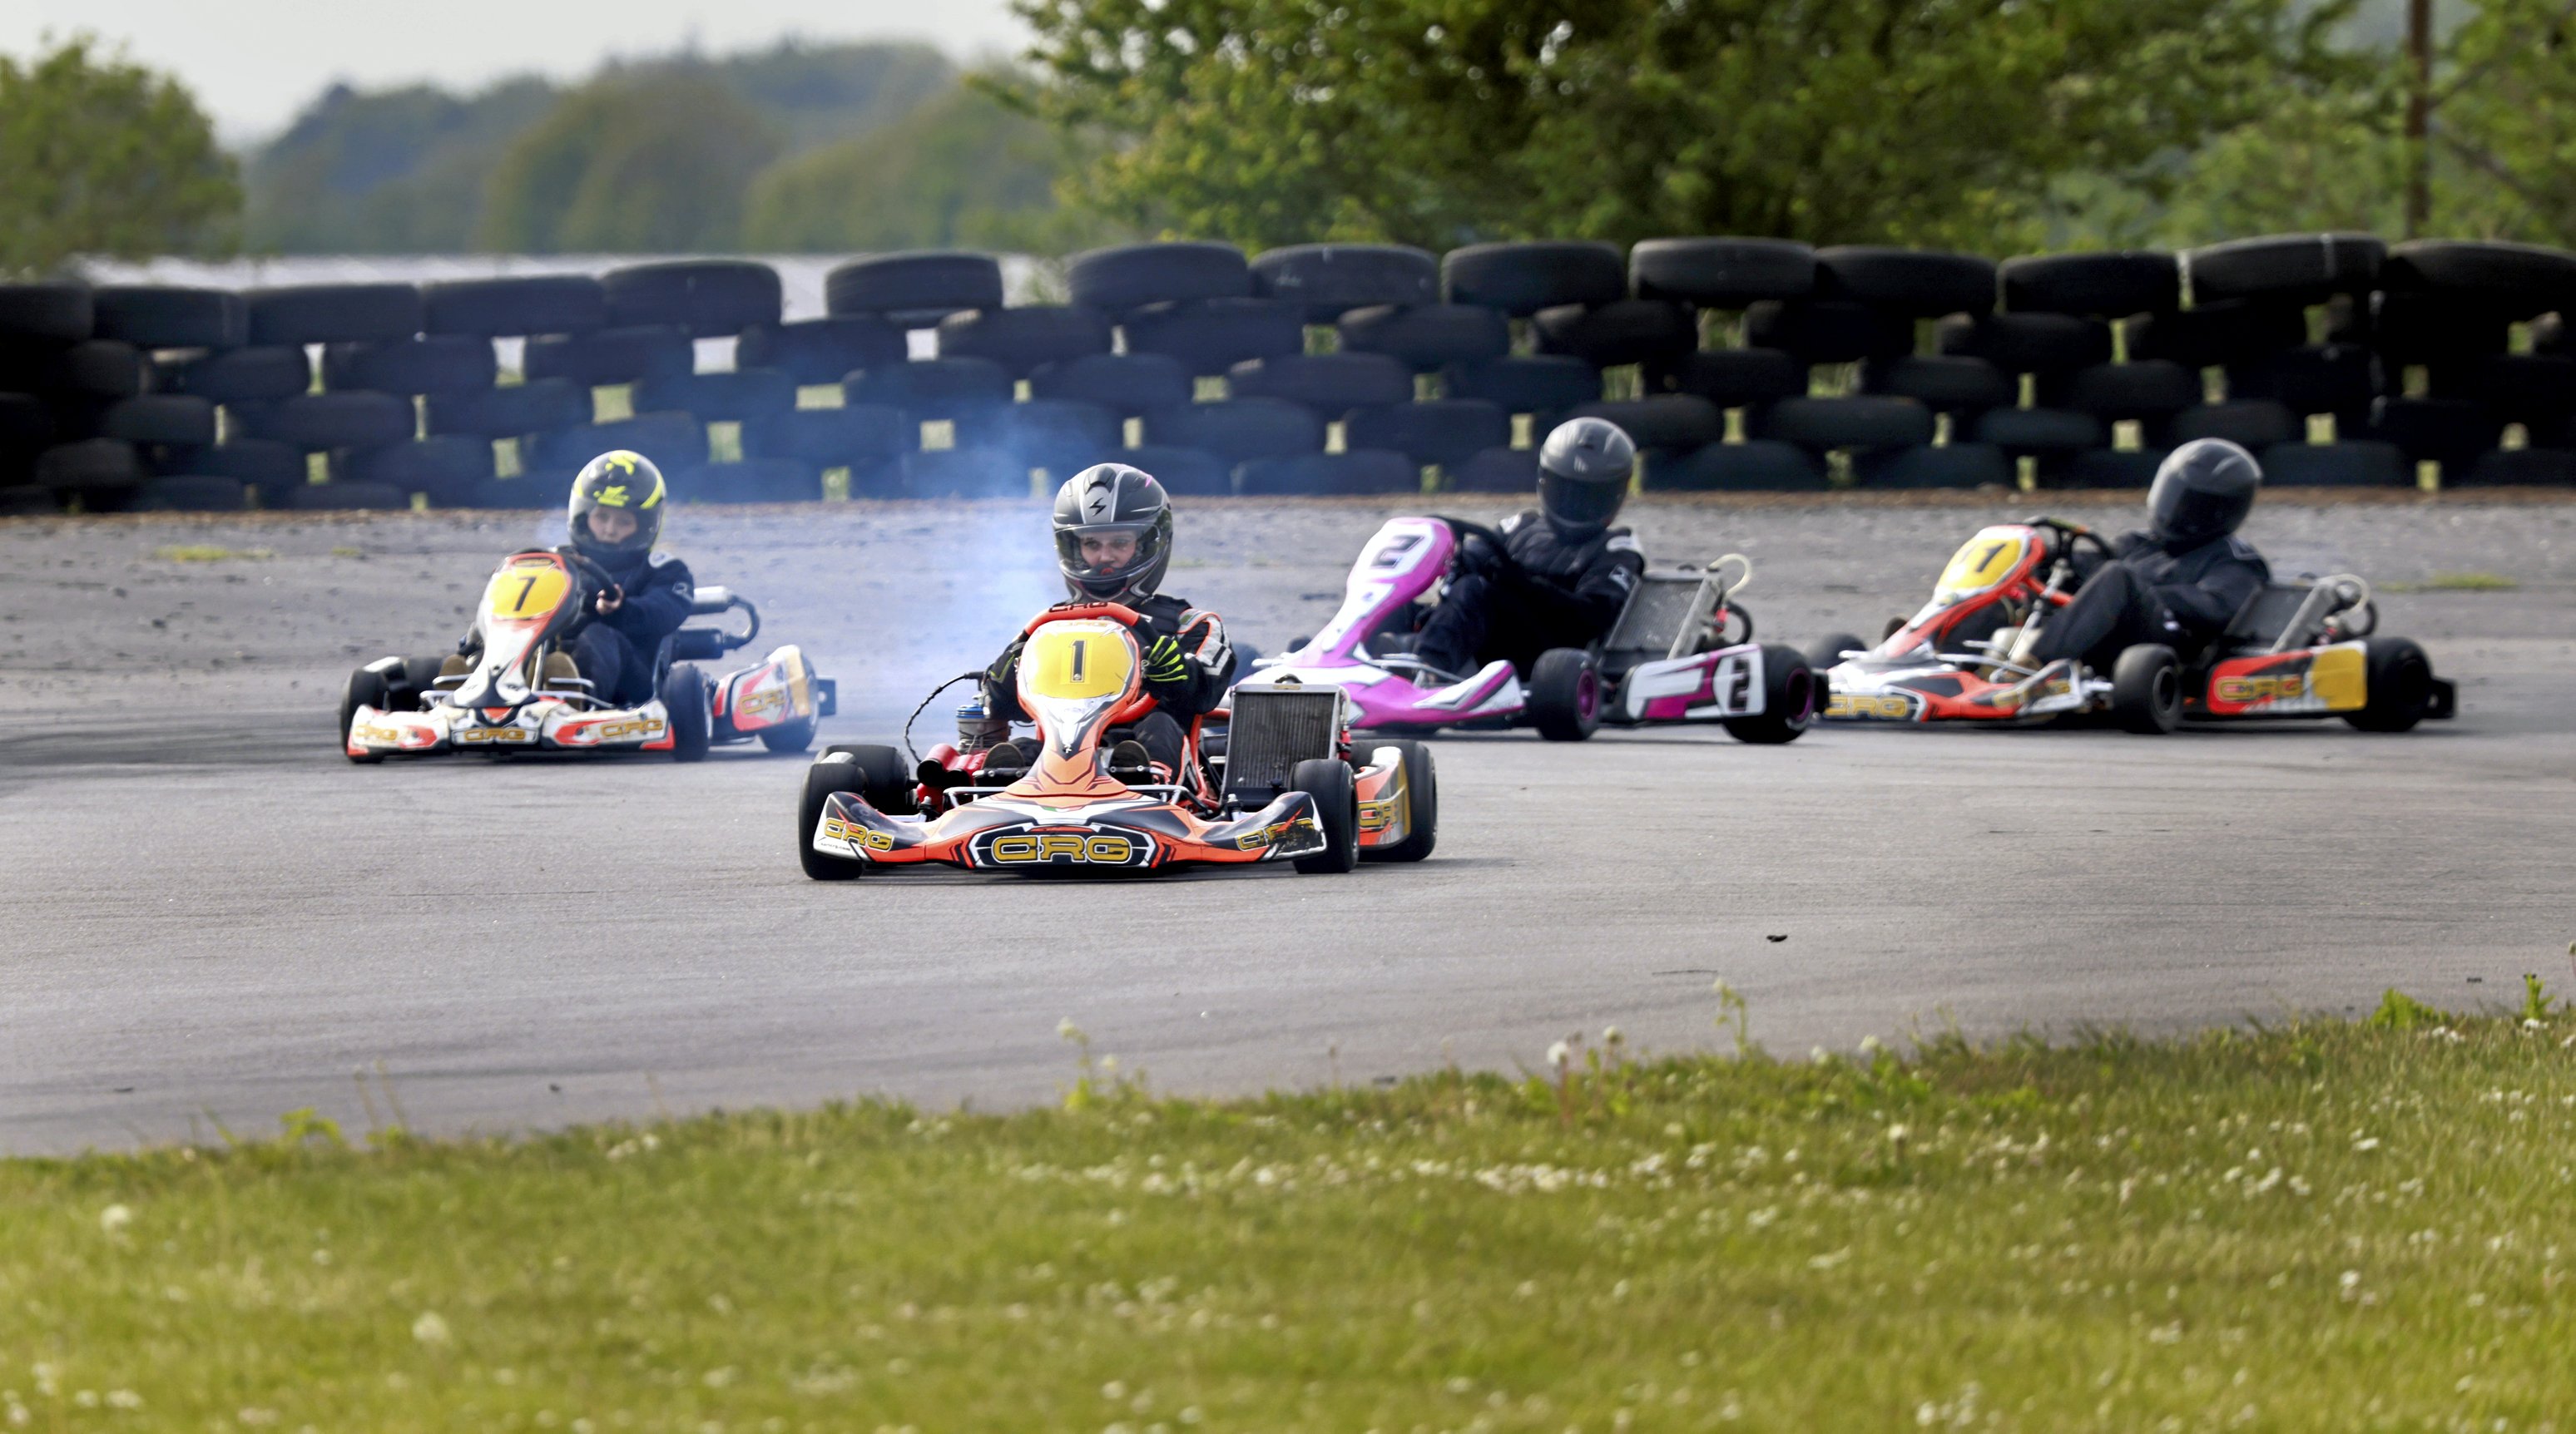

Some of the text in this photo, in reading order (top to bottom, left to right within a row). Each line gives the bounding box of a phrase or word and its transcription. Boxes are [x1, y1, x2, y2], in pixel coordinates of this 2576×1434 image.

[513, 575, 537, 612] 7
[1069, 639, 1087, 682] 1
[1729, 655, 1751, 712] 2
[464, 728, 526, 741] CRG
[601, 718, 663, 737] CRG
[825, 818, 893, 852] CRG
[992, 835, 1132, 863] CRG
